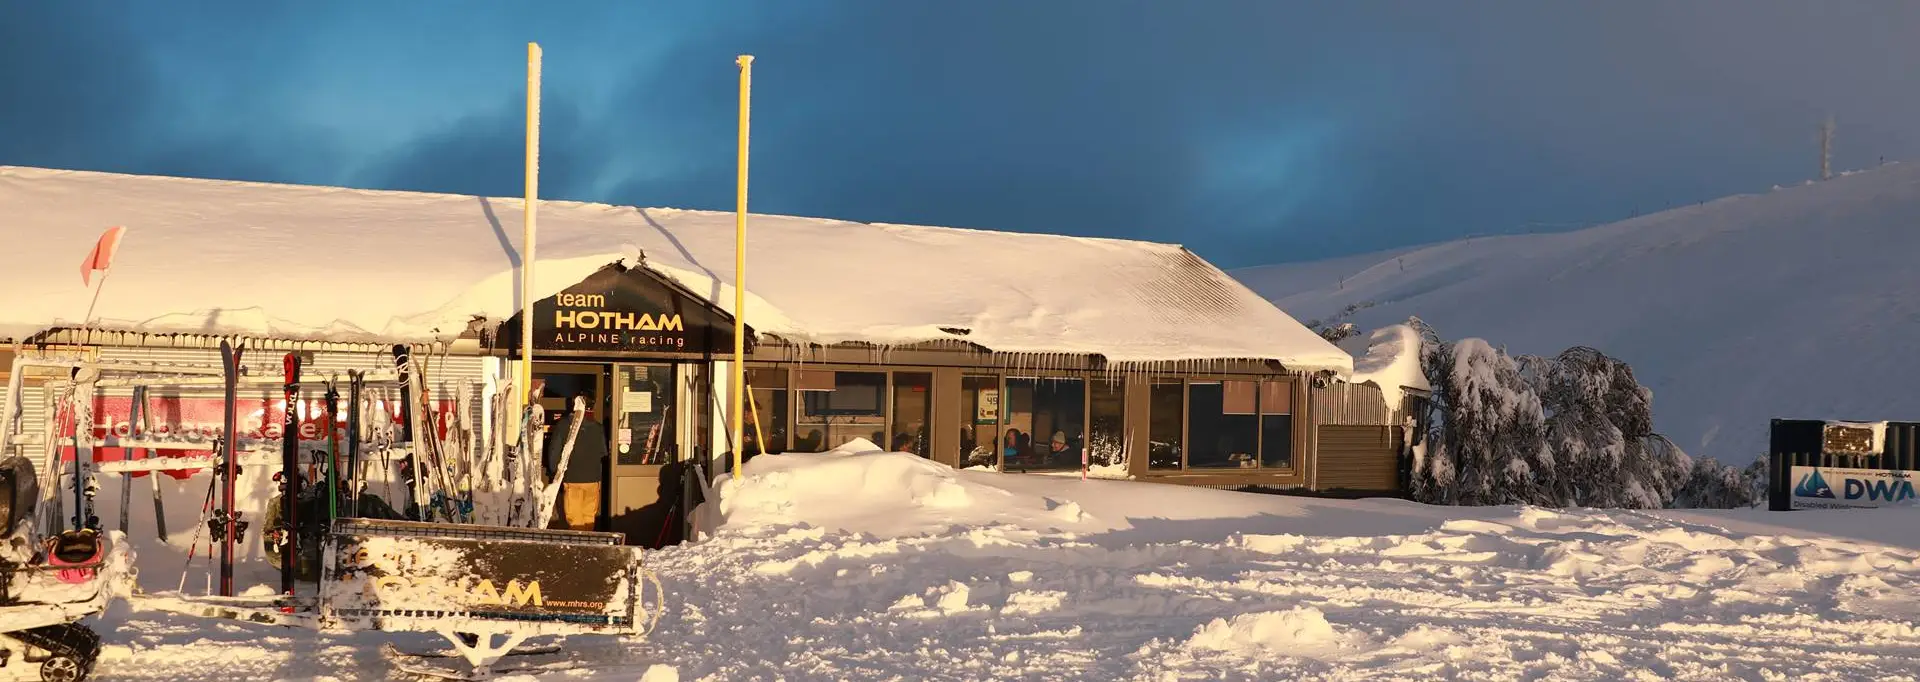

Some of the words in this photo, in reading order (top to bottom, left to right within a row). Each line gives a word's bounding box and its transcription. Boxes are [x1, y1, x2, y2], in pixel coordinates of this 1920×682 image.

[556, 291, 605, 308] team
[555, 311, 683, 331] HOTHAM
[555, 333, 619, 344] ALPINE
[631, 336, 684, 347] racing
[1845, 478, 1915, 501] DWA
[1793, 500, 1829, 509] Disabled
